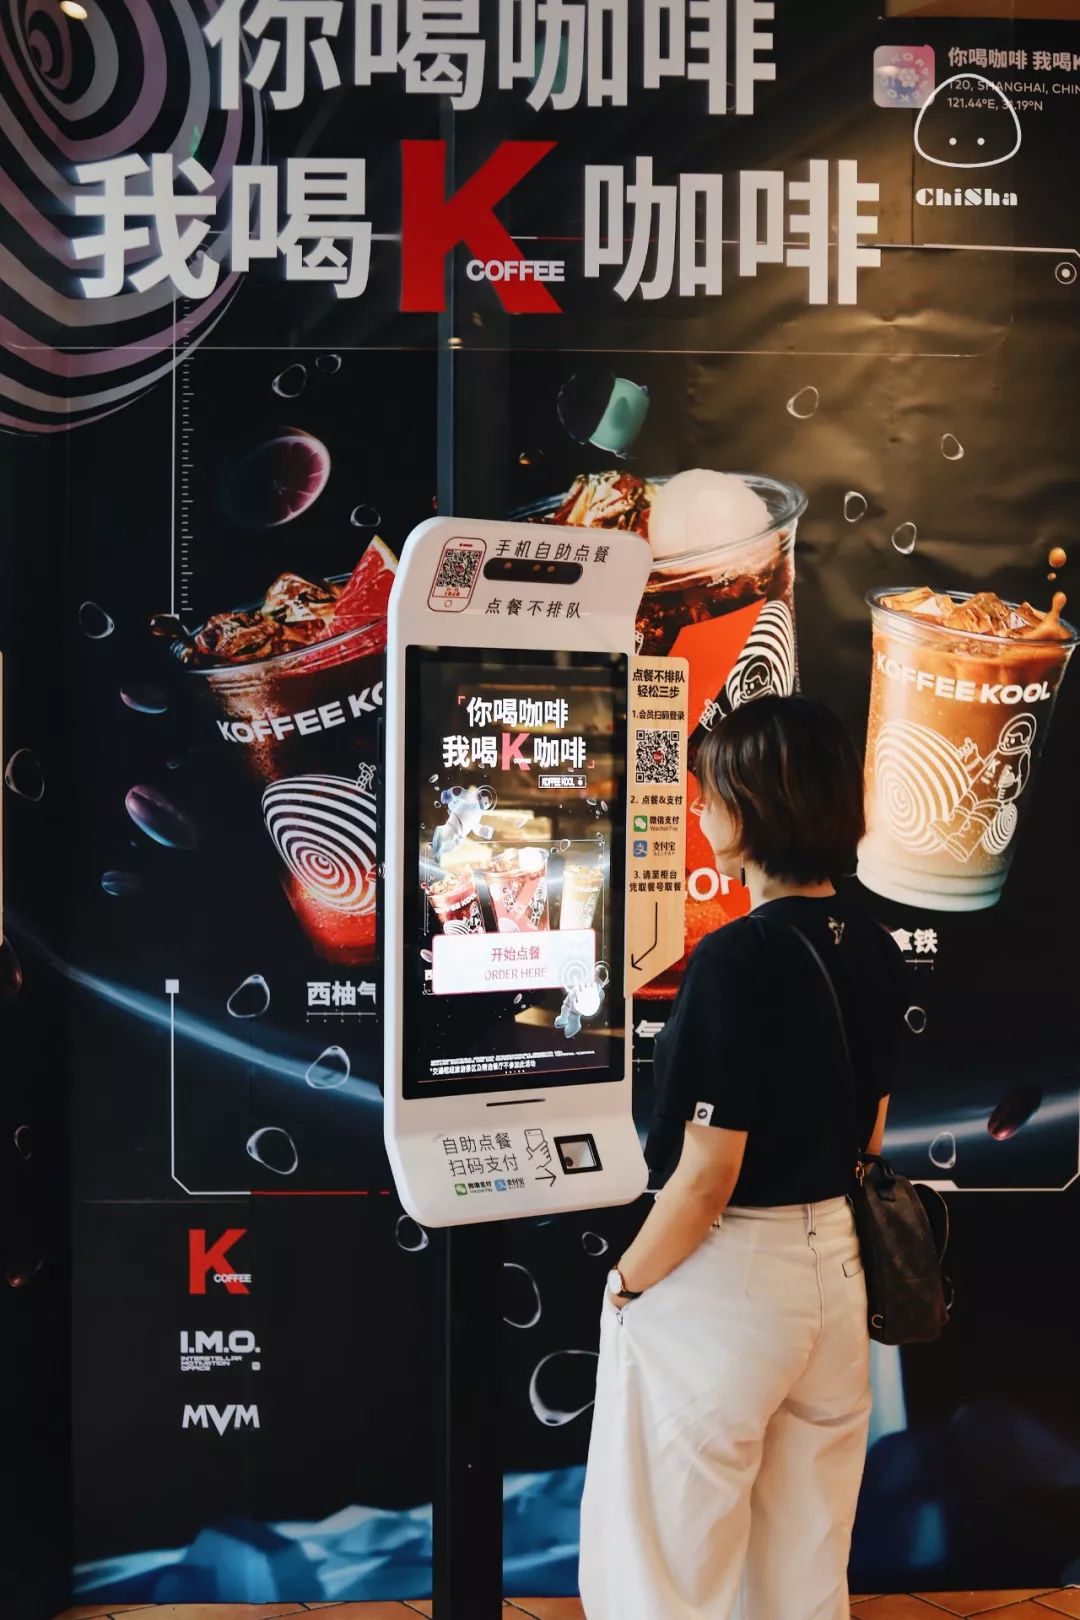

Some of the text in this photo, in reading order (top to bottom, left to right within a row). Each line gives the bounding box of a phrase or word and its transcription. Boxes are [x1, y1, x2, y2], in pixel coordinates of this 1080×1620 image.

[204, 0, 777, 115] 你喝咖啡
[947, 47, 1028, 70] 你喝咖啡
[977, 80, 1049, 95] SHANGHAI,
[465, 259, 566, 283] COFFEE
[494, 539, 611, 564] 手机自助点餐
[484, 597, 583, 619] 点餐不排队
[632, 668, 686, 683] 点餐不排队
[877, 650, 1051, 705] KOFFEE KOOL
[637, 684, 680, 699] 轻松三步
[216, 700, 346, 744] KOFFEE
[466, 697, 569, 729] 你喝咖啡
[649, 815, 680, 825] 微信支付
[653, 841, 676, 851] 支付宝
[491, 946, 541, 961] 开始点餐
[484, 967, 547, 981] ORDER HERE
[442, 1132, 512, 1155] 自助点餐
[448, 1153, 519, 1177] 扫码支付
[188, 1228, 249, 1295] K
[213, 1273, 252, 1283] COFFEE
[180, 1330, 261, 1353] I.M.O.
[181, 1404, 261, 1437] MVM
